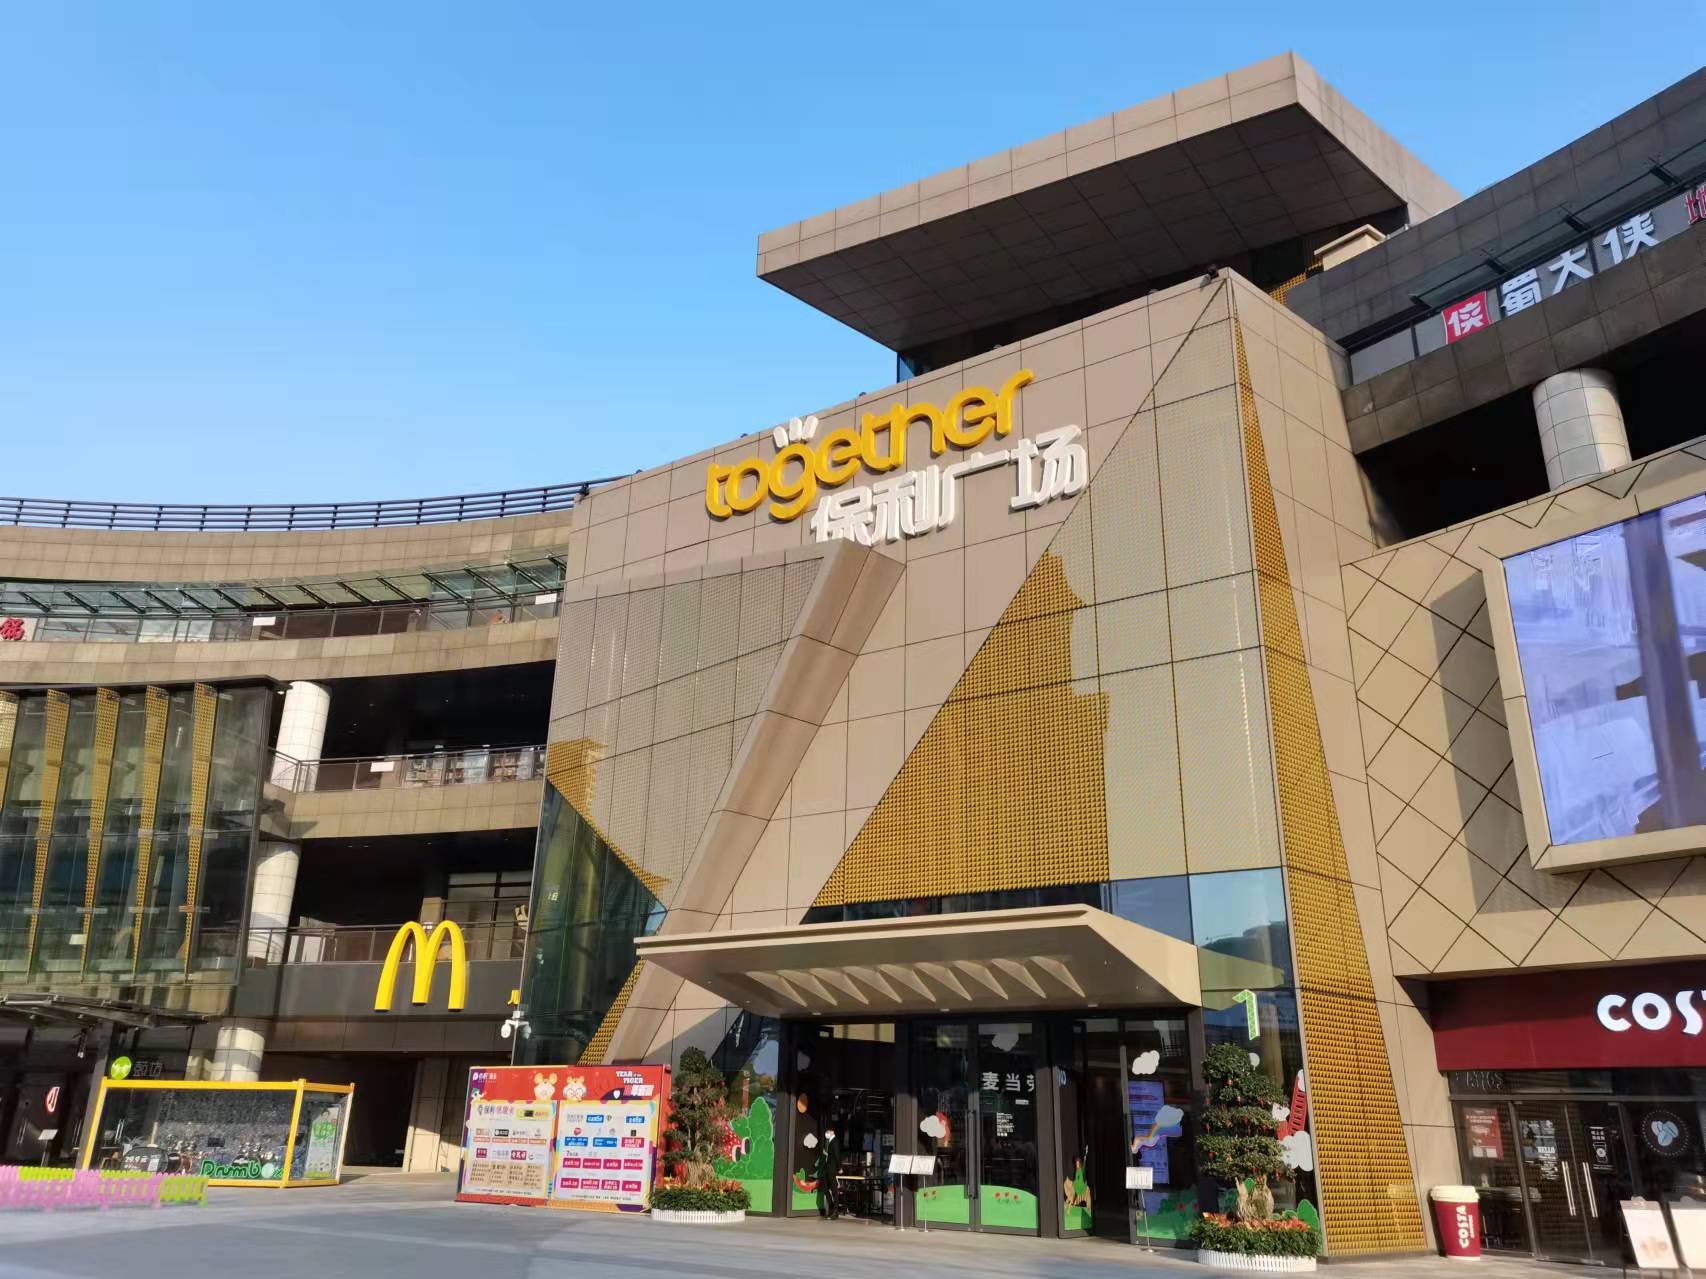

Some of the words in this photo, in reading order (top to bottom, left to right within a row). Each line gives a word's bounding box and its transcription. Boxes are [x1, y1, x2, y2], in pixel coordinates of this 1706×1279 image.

[1500, 212, 1660, 317] 蜀大侠
[705, 368, 1035, 521] together
[809, 423, 1089, 547] 保利广场
[1597, 989, 1706, 1036] COS
[615, 1070, 633, 1078] YEAR
[1456, 1205, 1470, 1249] COSTA
